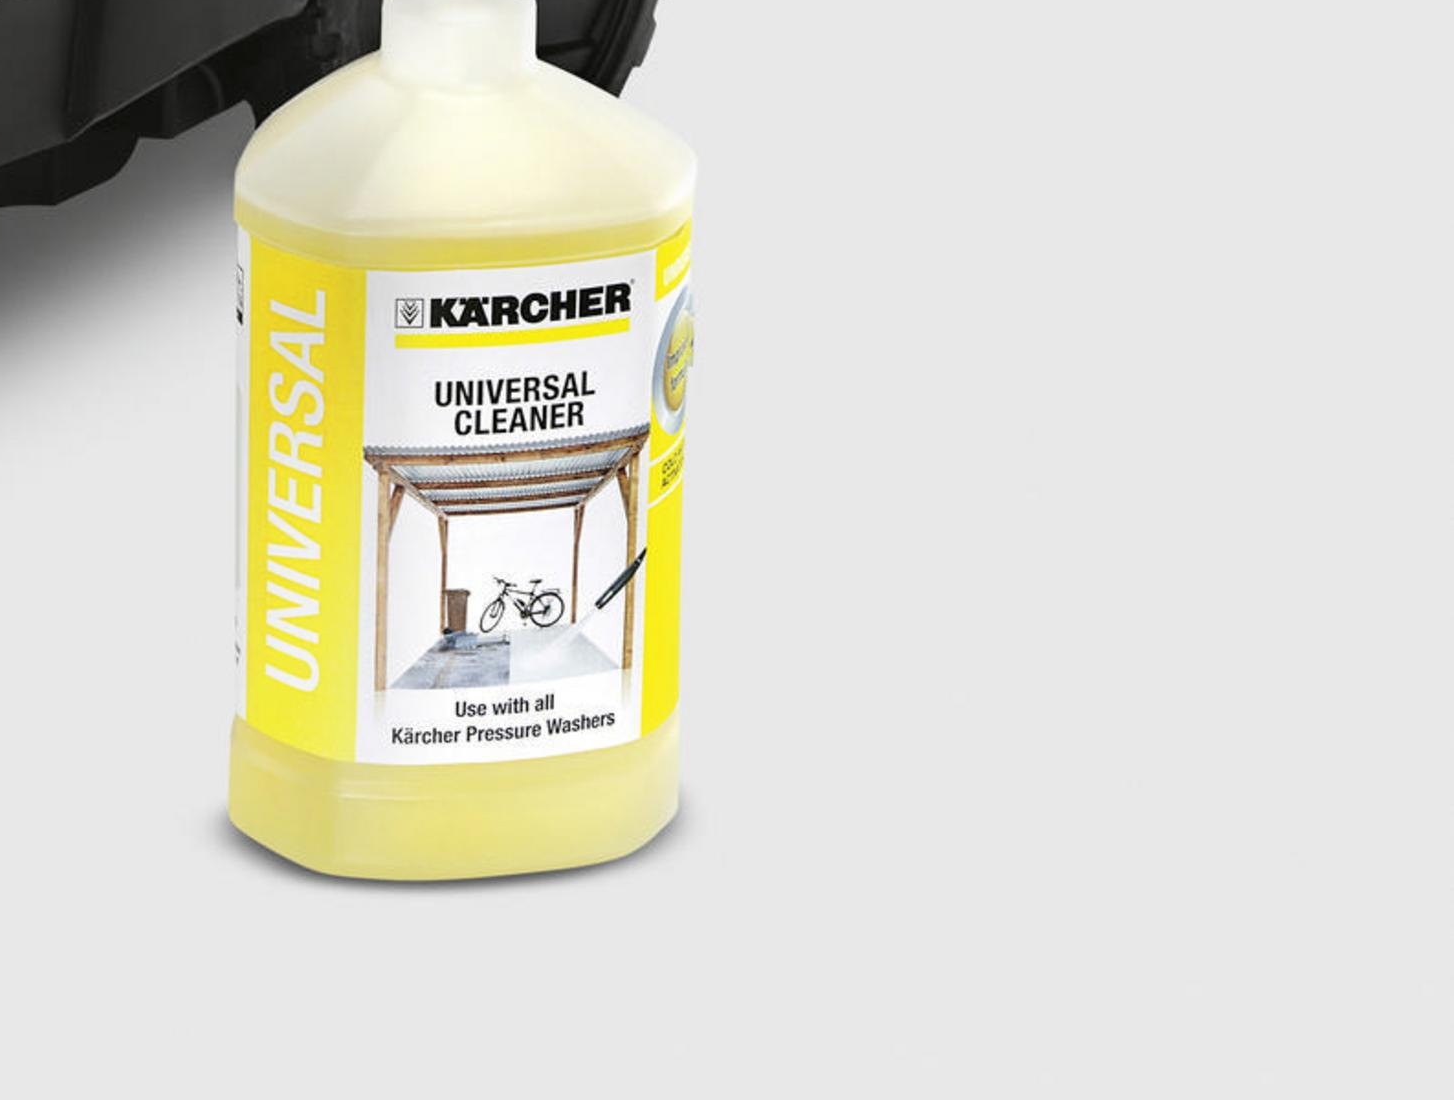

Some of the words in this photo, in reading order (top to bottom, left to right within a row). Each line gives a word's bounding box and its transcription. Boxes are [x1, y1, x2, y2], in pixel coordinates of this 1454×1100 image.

[430, 282, 631, 328] KÄRCHER
[435, 370, 596, 407] UNIVERSAL
[454, 401, 584, 436] CLEANER
[265, 289, 326, 693] UNIVERSAL
[455, 701, 487, 718] Use
[492, 697, 529, 715] with
[534, 694, 555, 711] all
[391, 727, 461, 745] Kärcher
[465, 723, 542, 743] Pressure
[546, 712, 615, 735] Washers
